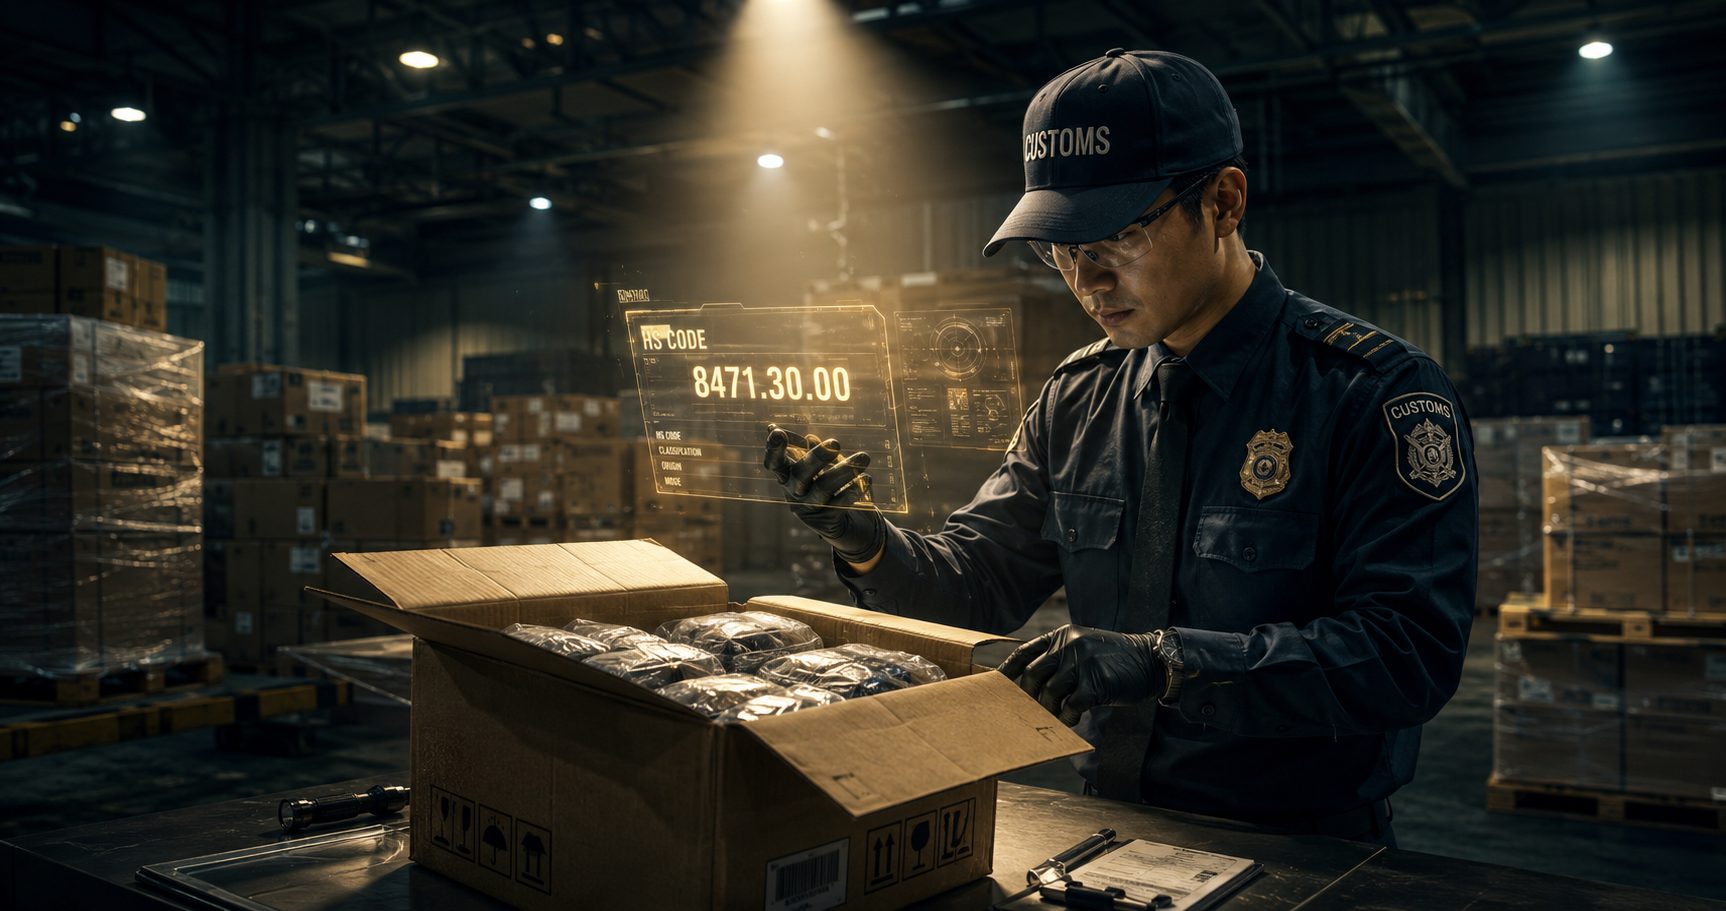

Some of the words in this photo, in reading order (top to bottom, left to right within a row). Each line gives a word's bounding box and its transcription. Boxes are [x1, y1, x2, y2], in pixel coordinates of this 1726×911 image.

[1024, 126, 1110, 162] CUSTOMS
[642, 330, 662, 350] HS
[667, 329, 707, 350] CODE
[693, 365, 850, 401] 8471.30.00
[1391, 400, 1451, 418] CUSTOMS
